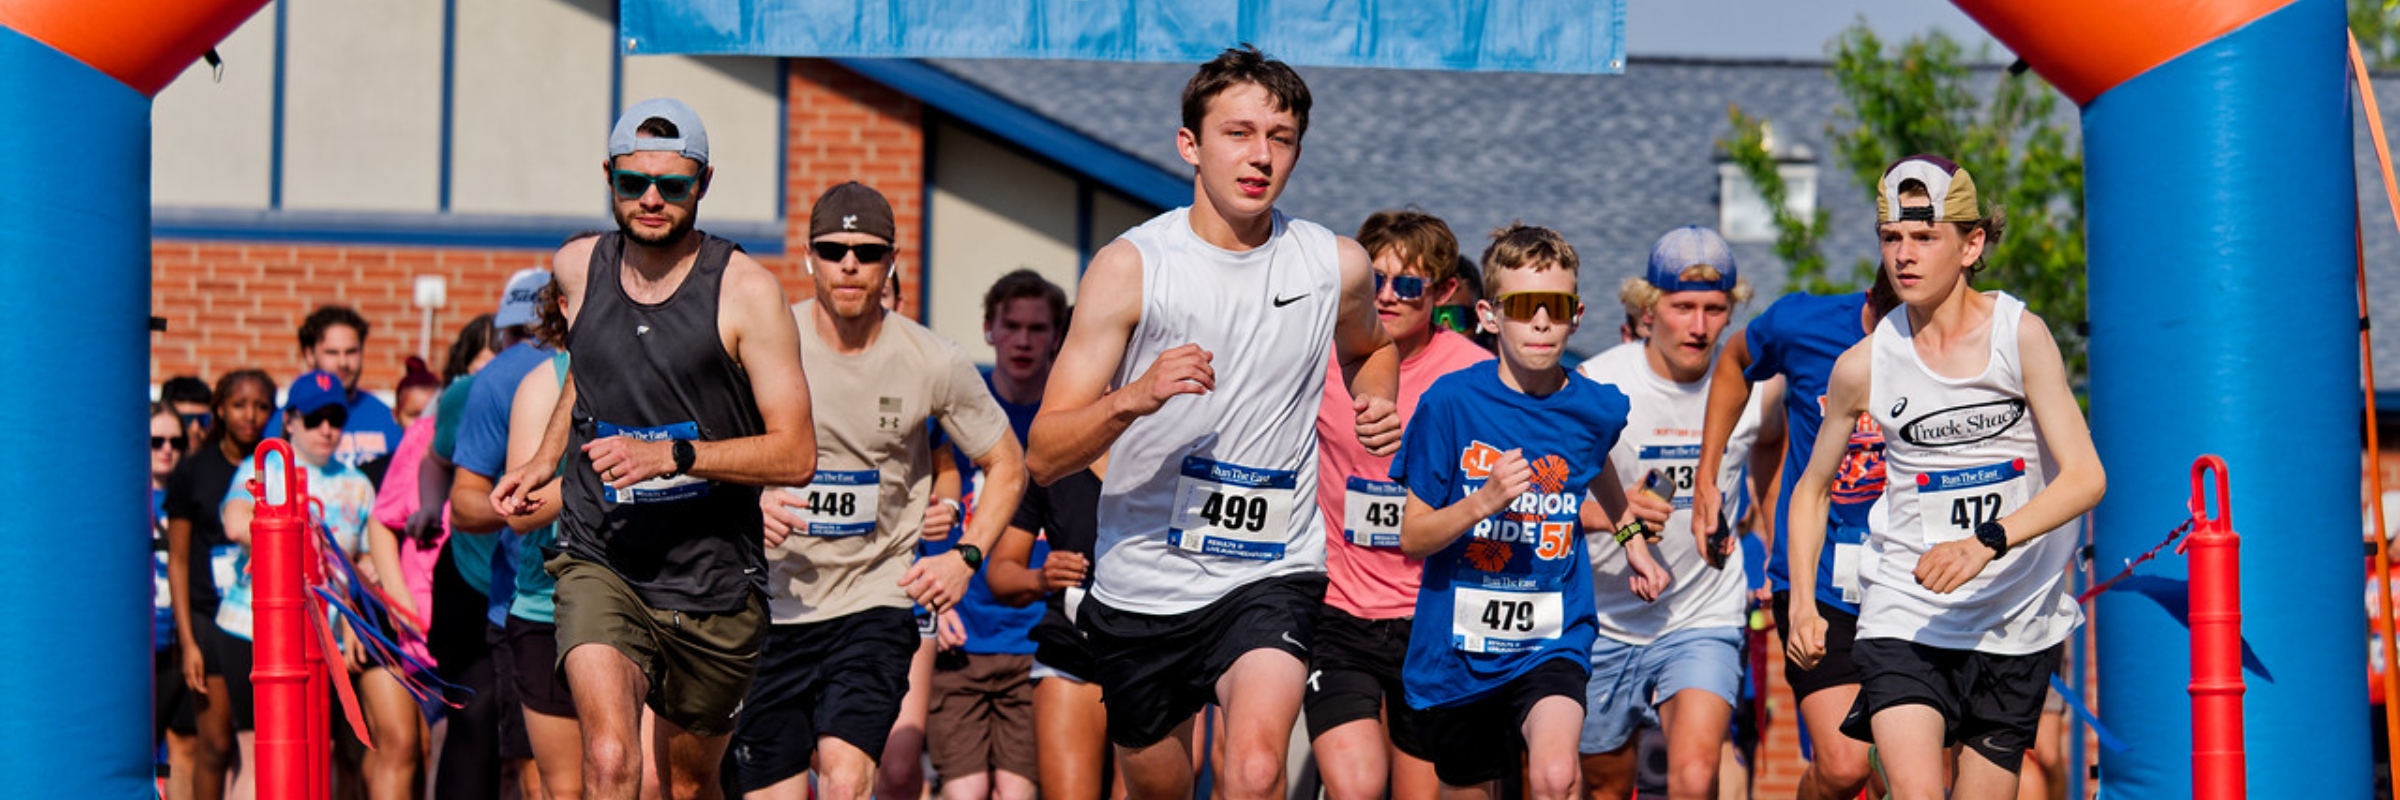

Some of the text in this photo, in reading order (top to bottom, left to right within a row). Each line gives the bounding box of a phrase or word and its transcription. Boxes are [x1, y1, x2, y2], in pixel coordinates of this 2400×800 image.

[1910, 414, 1962, 443] Track
[1966, 400, 2022, 431] Shack
[1477, 449, 1494, 472] L
[1211, 465, 1271, 483] Run The East
[1941, 468, 1999, 485] Run The East
[806, 491, 856, 517] 448
[1200, 491, 1269, 533] 499
[1366, 502, 1407, 527] 43
[1950, 493, 2003, 529] 472
[1473, 517, 1537, 544] RIDE
[1481, 599, 1535, 632] 479
